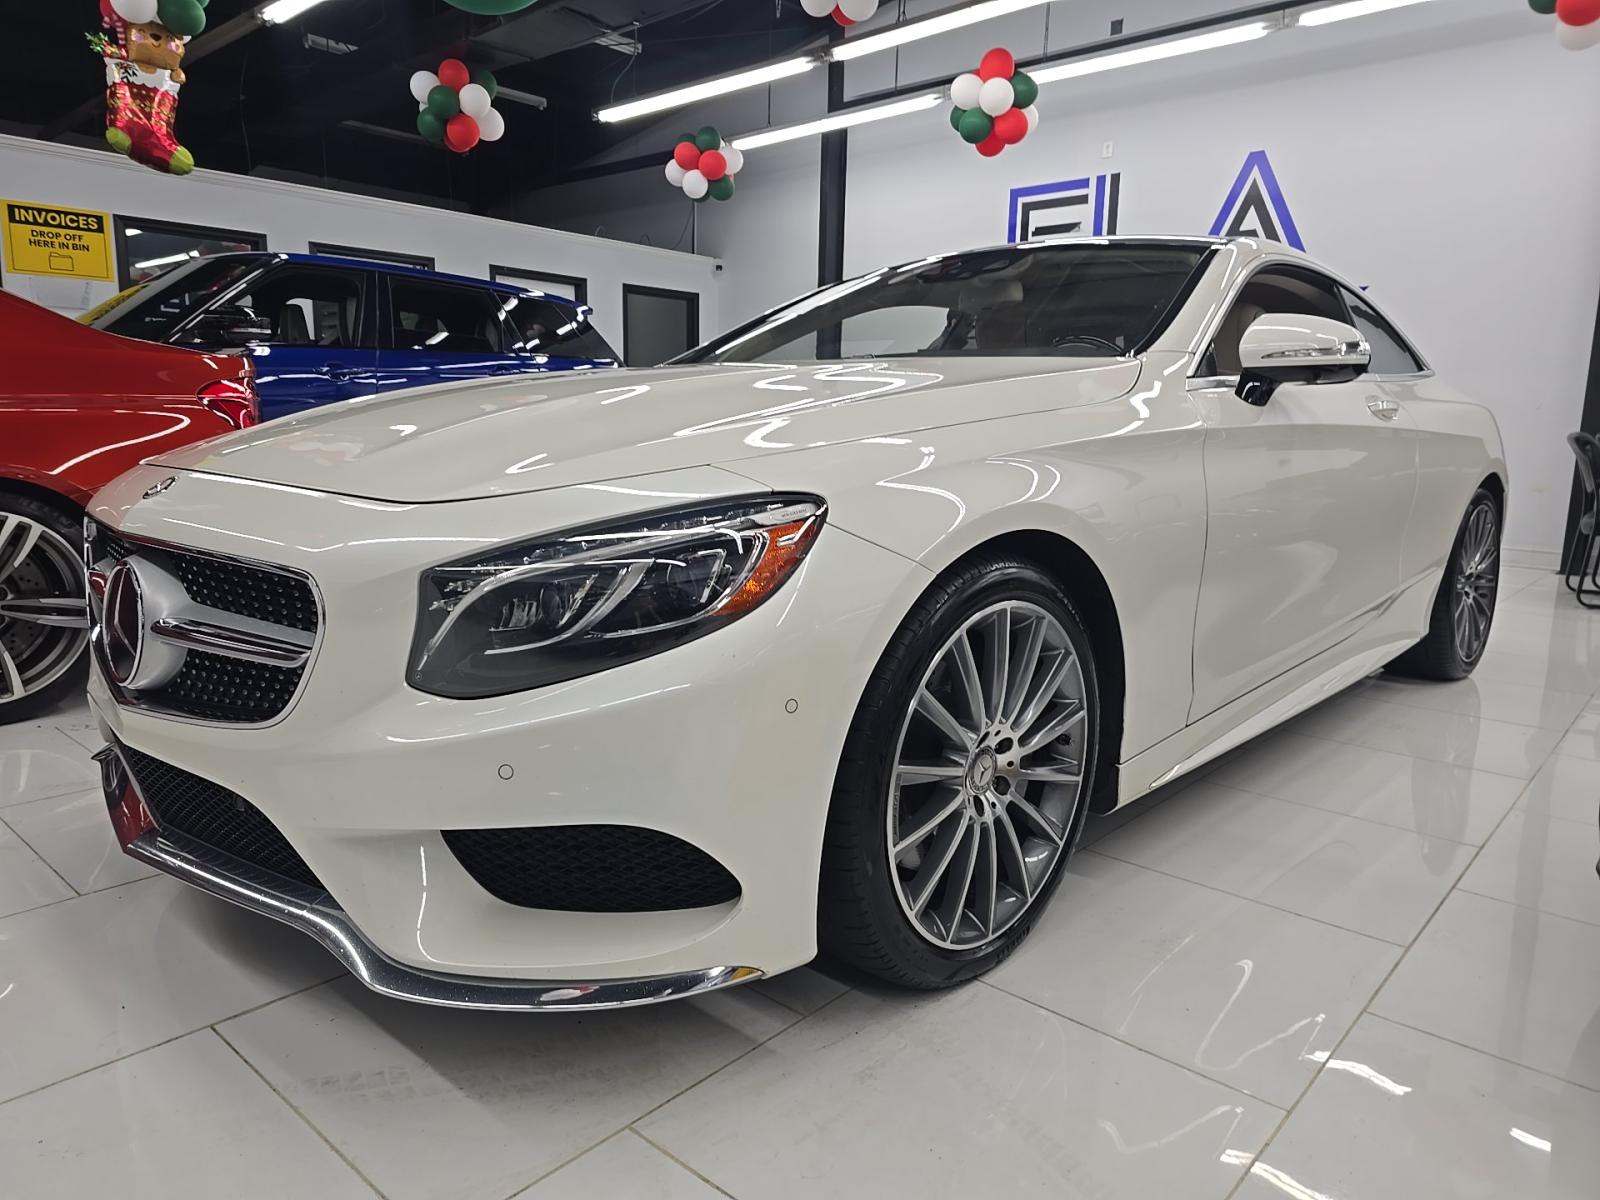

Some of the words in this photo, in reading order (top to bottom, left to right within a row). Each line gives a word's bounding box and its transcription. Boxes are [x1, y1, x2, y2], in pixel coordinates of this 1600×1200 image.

[14, 207, 98, 230] INVOICES
[31, 229, 62, 240] DROP
[64, 233, 84, 243] OFF
[28, 238, 57, 249] HERE
[58, 241, 70, 250] IN
[72, 243, 90, 253] BIN
